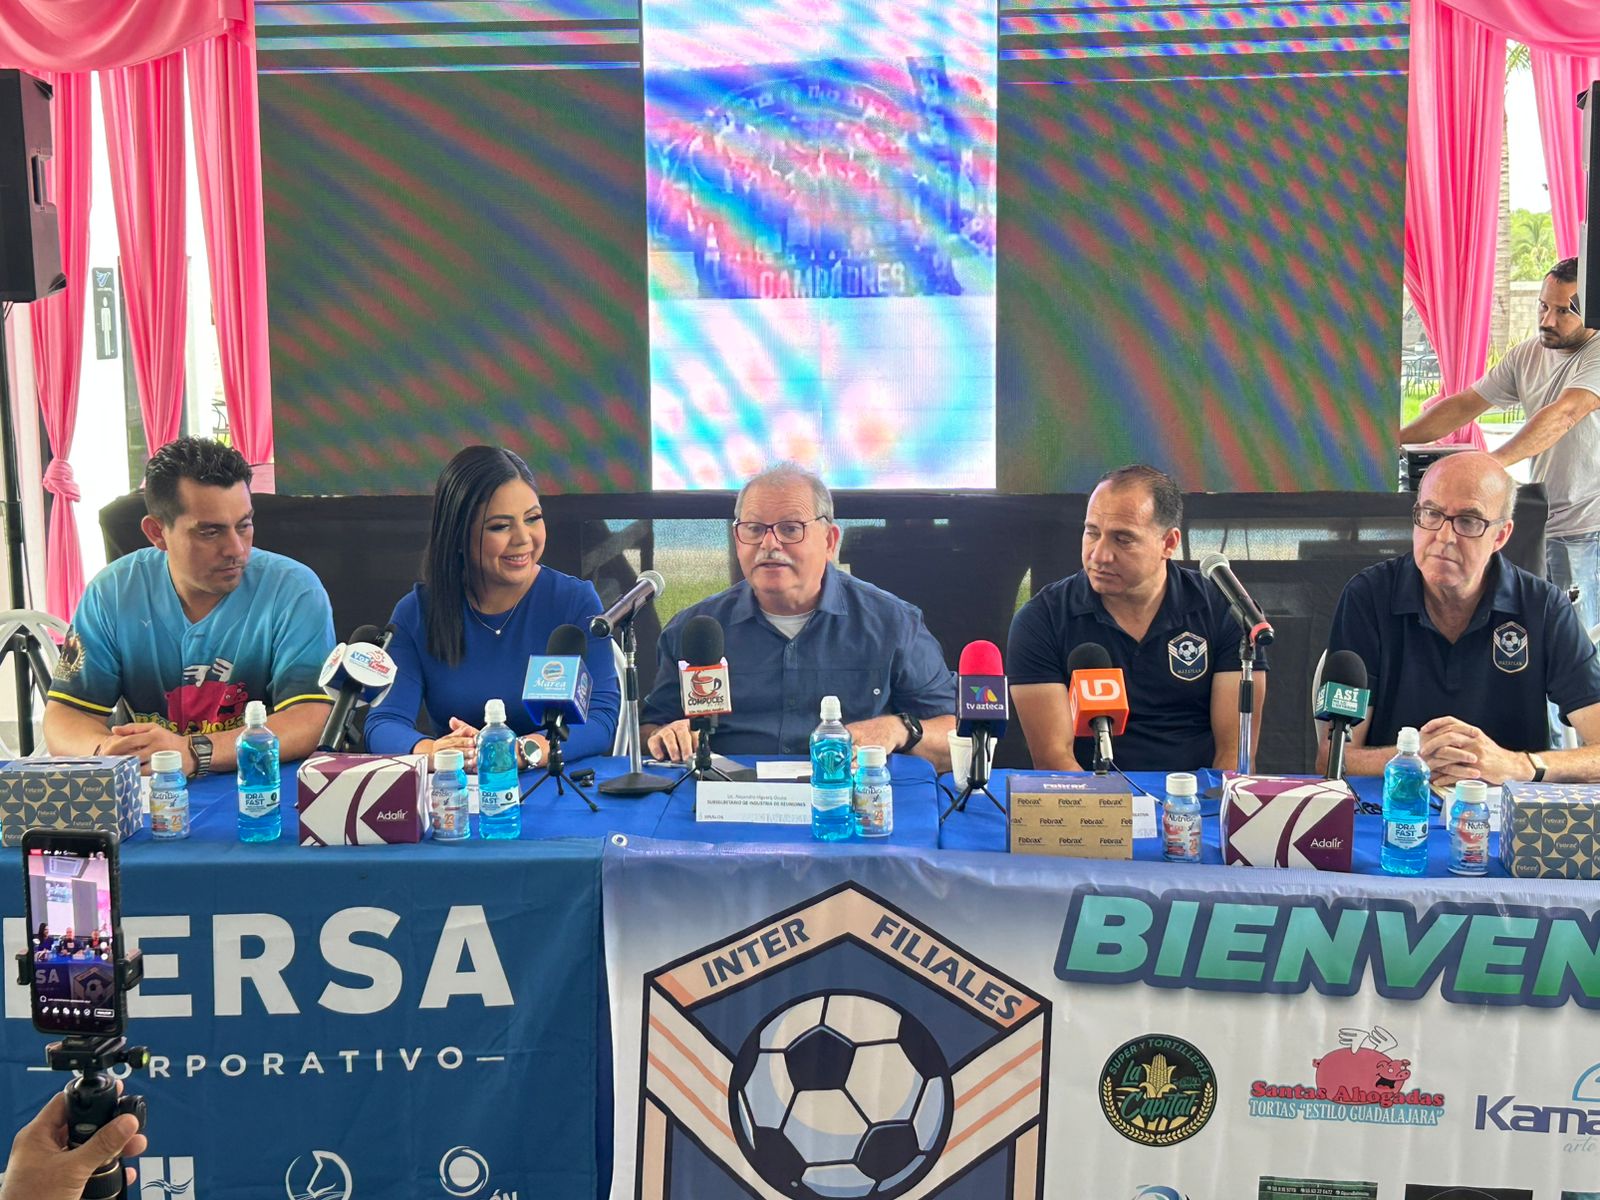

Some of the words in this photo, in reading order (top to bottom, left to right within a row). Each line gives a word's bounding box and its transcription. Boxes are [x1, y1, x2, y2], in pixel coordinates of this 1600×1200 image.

[3, 904, 515, 1018] ERSA
[1064, 892, 1600, 1000] BIENVEN
[701, 917, 811, 988] INTER
[871, 915, 1023, 1021] FILIALES
[72, 1046, 464, 1081] ORPORATIVO
[1109, 1044, 1138, 1075] SUPER
[1121, 1060, 1142, 1086] La
[1121, 1091, 1196, 1123] Capital
[1250, 1100, 1297, 1118] TORTAS
[1251, 1081, 1327, 1100] Santas
[1333, 1085, 1445, 1107] Ahogadas
